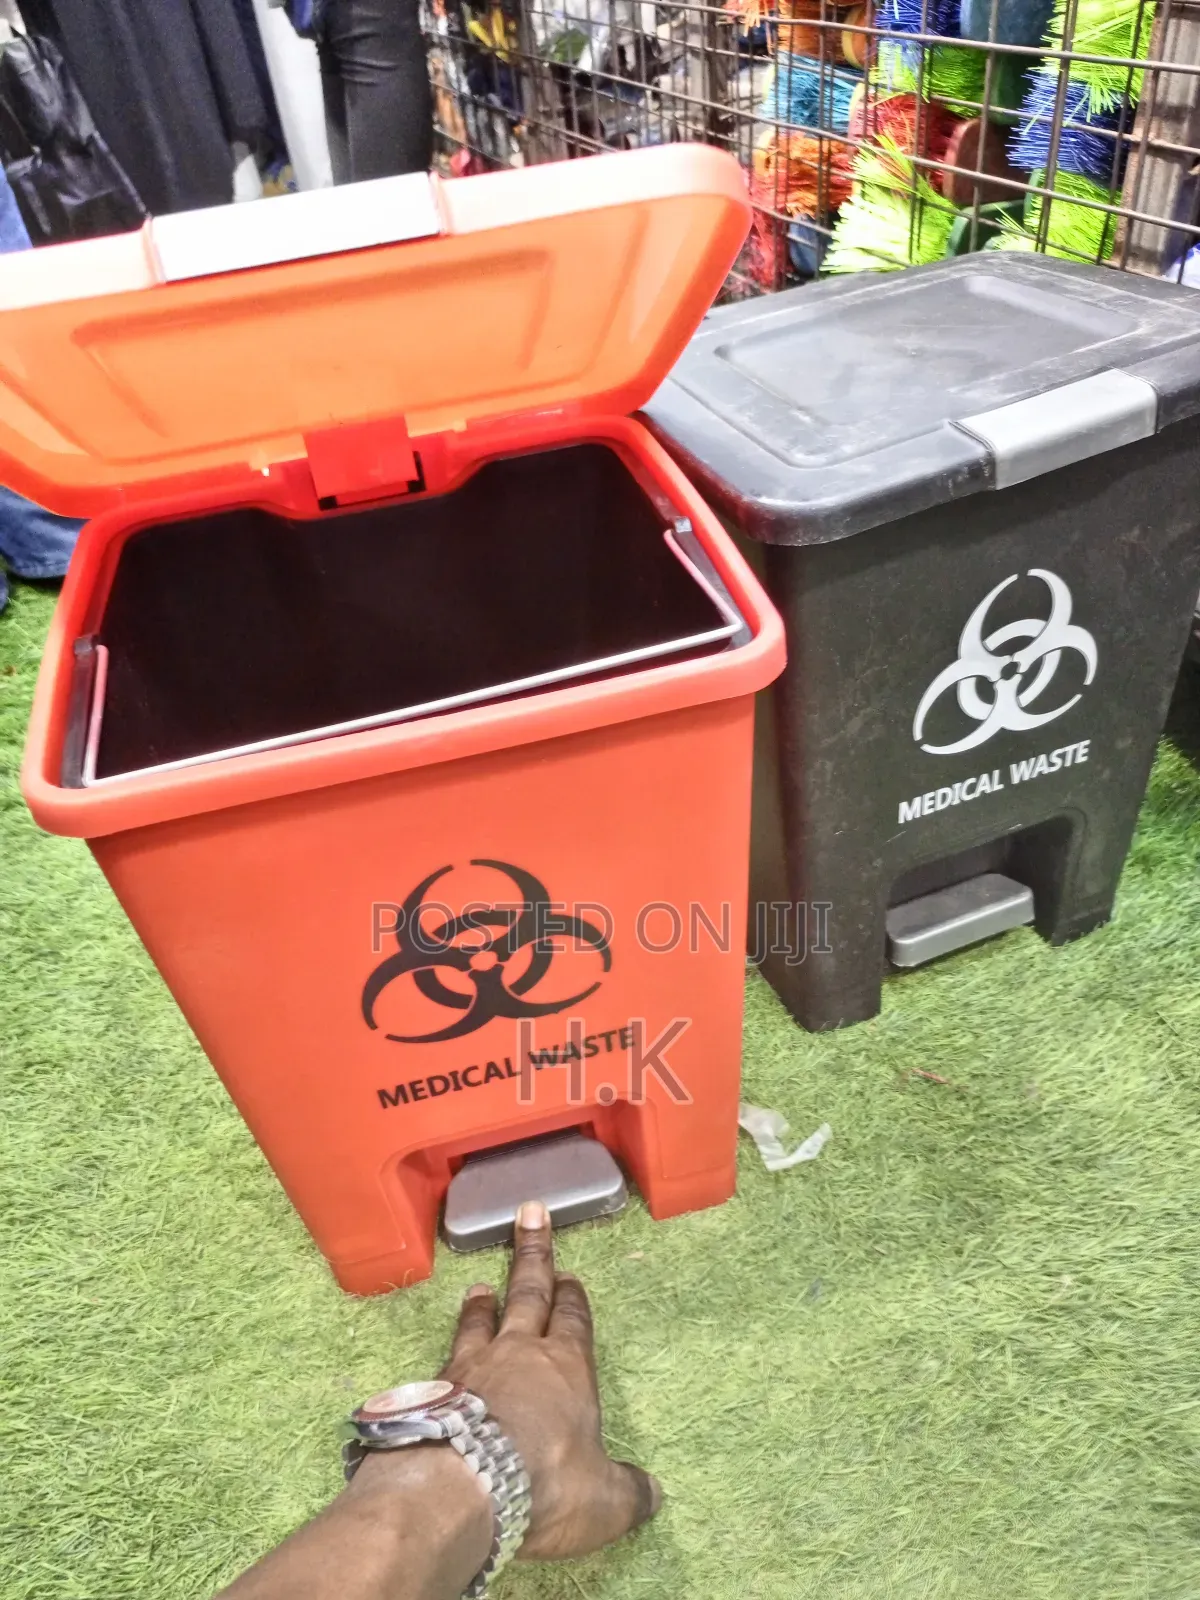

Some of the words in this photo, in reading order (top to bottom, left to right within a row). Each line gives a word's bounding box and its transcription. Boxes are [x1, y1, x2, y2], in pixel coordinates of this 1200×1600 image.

[898, 769, 1004, 824] MEDICAL
[1009, 739, 1091, 785] WASTE
[377, 1057, 522, 1110] MEDICAL
[527, 1026, 637, 1072] WASTE
